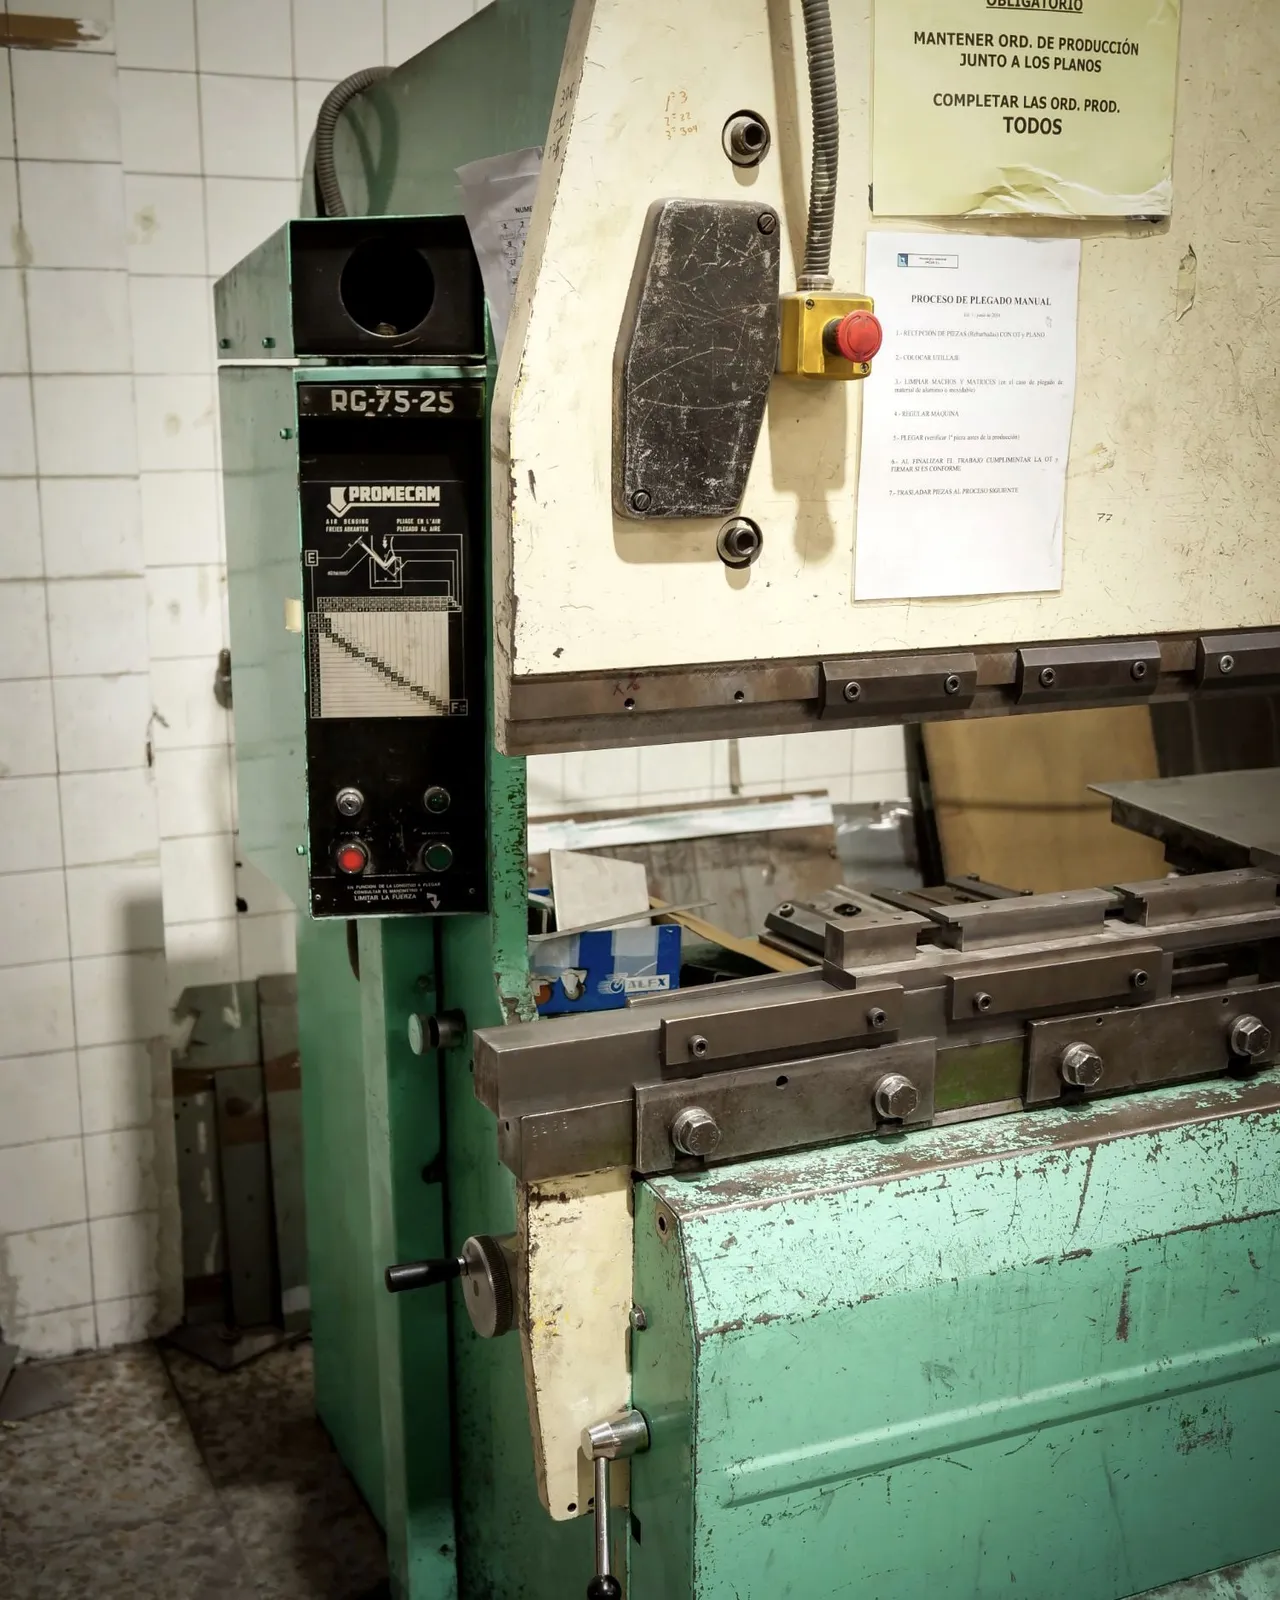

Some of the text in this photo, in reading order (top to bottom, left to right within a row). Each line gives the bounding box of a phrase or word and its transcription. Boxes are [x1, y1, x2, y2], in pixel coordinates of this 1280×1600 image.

[914, 31, 1139, 56] MANTENER ORD. DE PRODUCCIÓN
[960, 53, 1102, 72] JUNTO A LOS PLANOS
[933, 93, 1120, 114] COMPLETAR LAS ORD. PROD.
[1003, 116, 1063, 135] TODOS
[911, 294, 1052, 306] PROCESO DE PLEGADO MANUAL
[331, 389, 455, 413] RG-75-25
[348, 486, 440, 501] PROMECAM
[308, 552, 316, 564] E
